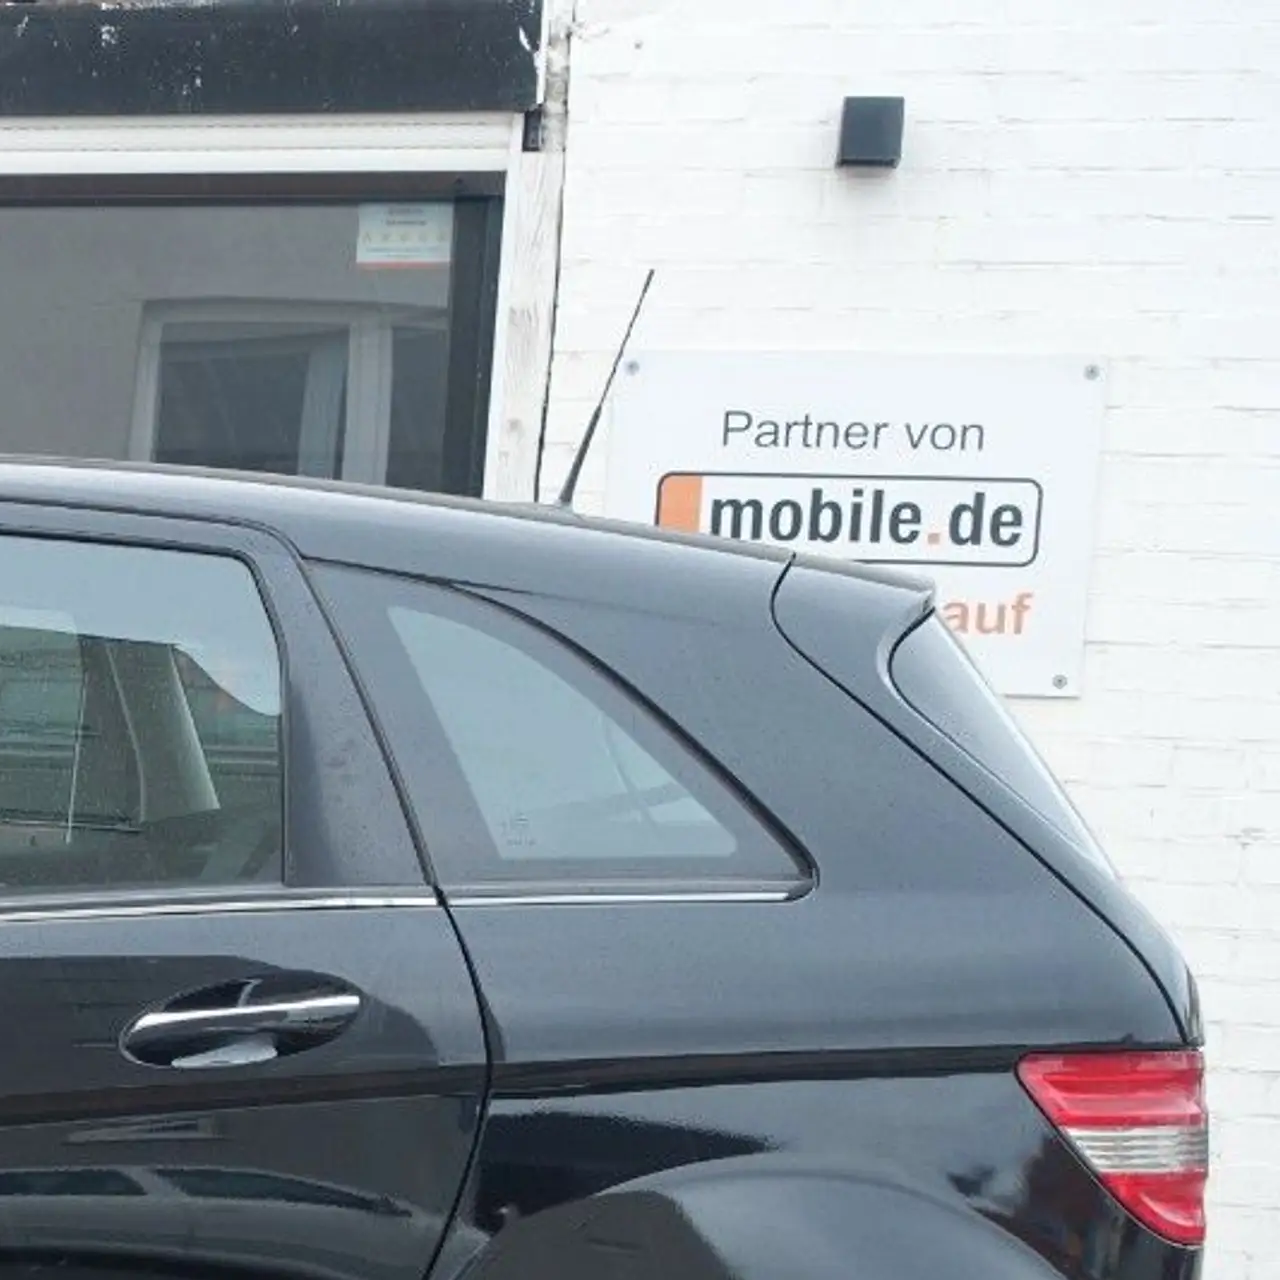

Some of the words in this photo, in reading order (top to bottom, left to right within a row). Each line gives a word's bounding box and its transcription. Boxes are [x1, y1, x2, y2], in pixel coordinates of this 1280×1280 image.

[721, 410, 889, 450] Partner
[904, 421, 985, 451] von
[709, 488, 1024, 546] mobile.de
